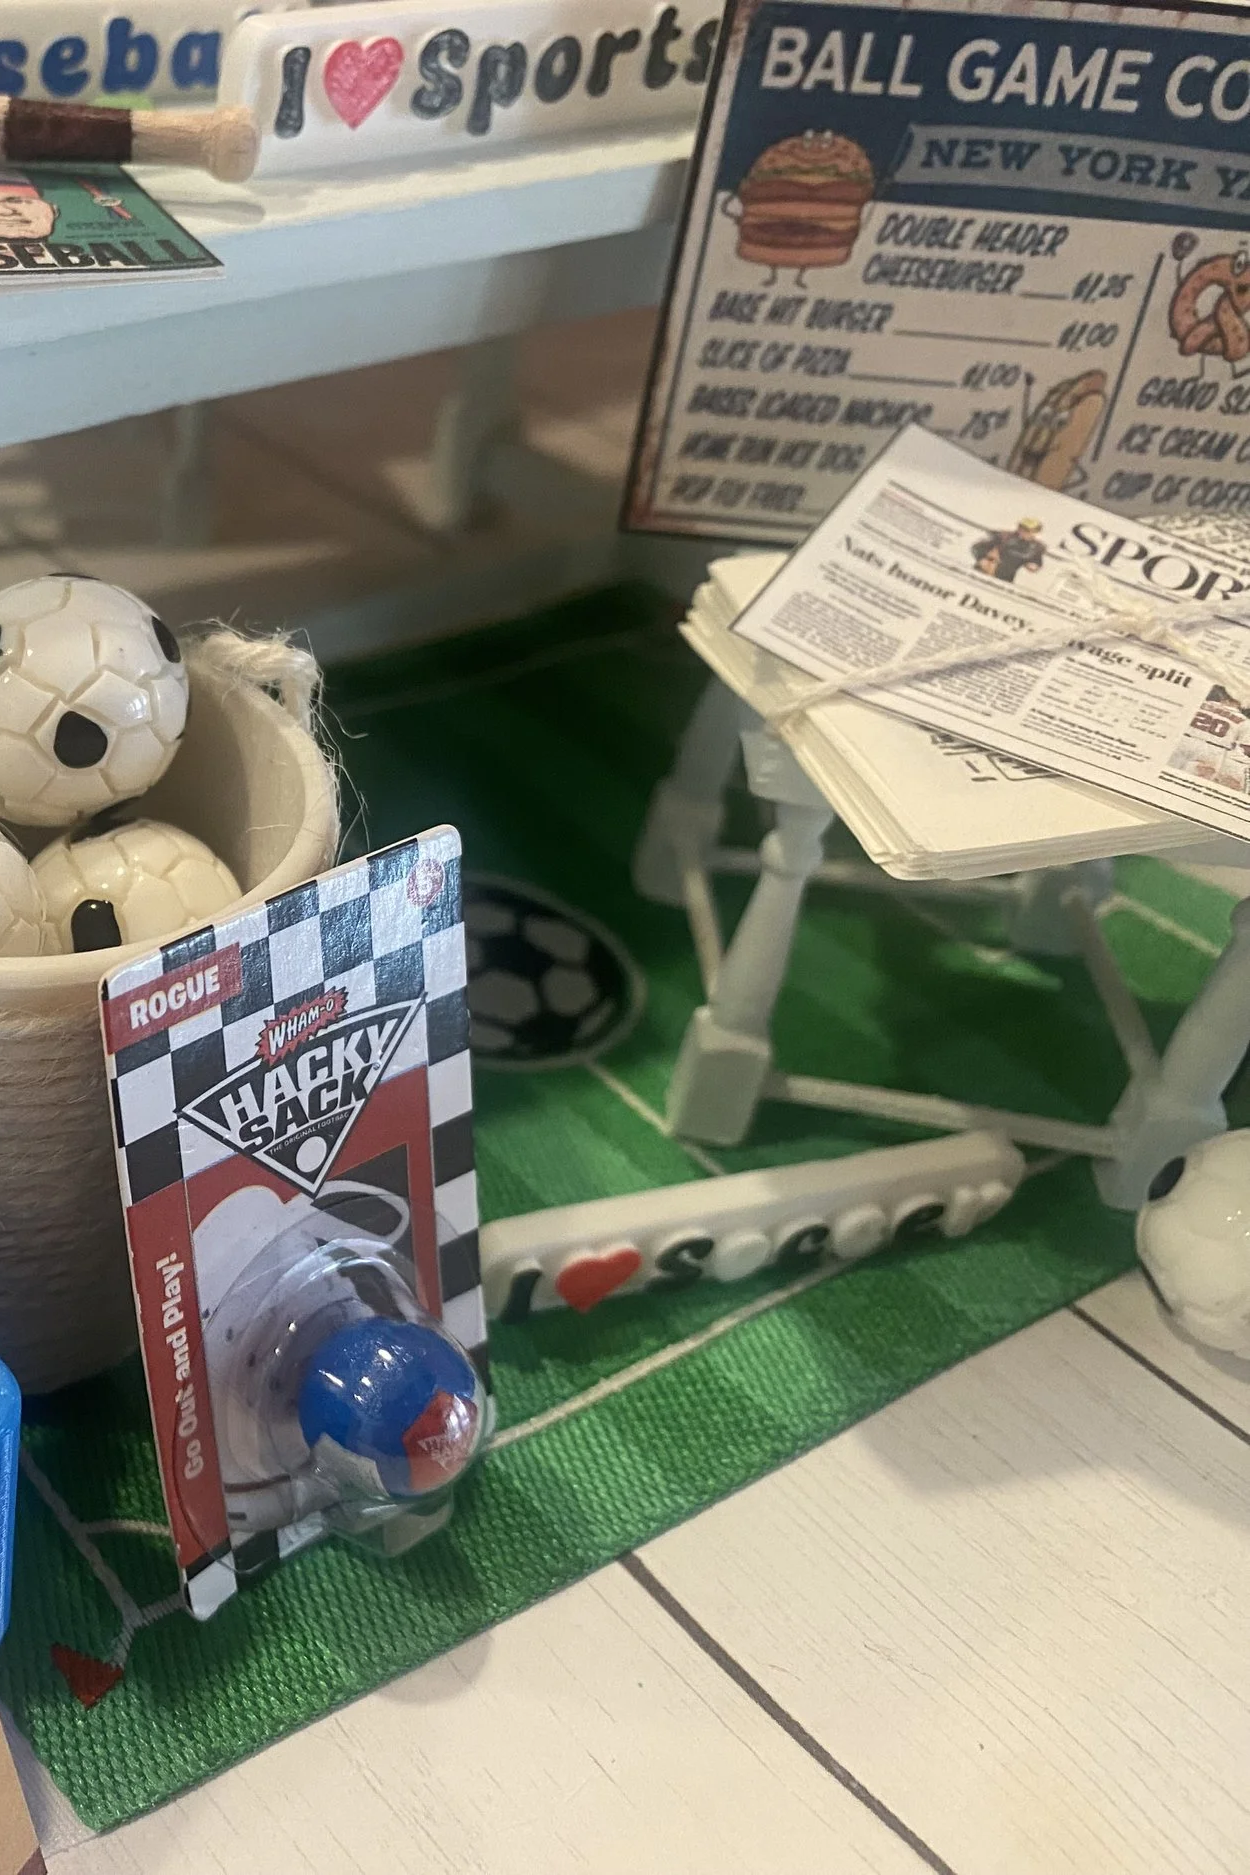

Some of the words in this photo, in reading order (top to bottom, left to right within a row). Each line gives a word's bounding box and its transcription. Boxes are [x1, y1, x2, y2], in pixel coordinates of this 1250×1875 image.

[410, 5, 718, 137] Sports
[760, 26, 924, 98] BALL
[947, 38, 1154, 115] GAME
[920, 137, 1035, 172] NEW
[1058, 143, 1198, 194] YORK
[876, 213, 974, 250] DOUBLE
[972, 221, 1069, 257] HEADER
[1059, 521, 1249, 601] SPOR
[1136, 663, 1194, 688] split
[129, 965, 221, 1031] ROGUE
[270, 998, 334, 1056] WHAM-O
[219, 1018, 399, 1132] HACKY
[238, 1062, 370, 1150] SACK
[284, 1126, 316, 1147] ORIGINAL
[155, 1251, 185, 1329] Play!
[165, 1330, 191, 1382] and
[174, 1382, 199, 1438] Out
[184, 1437, 204, 1480] Go
